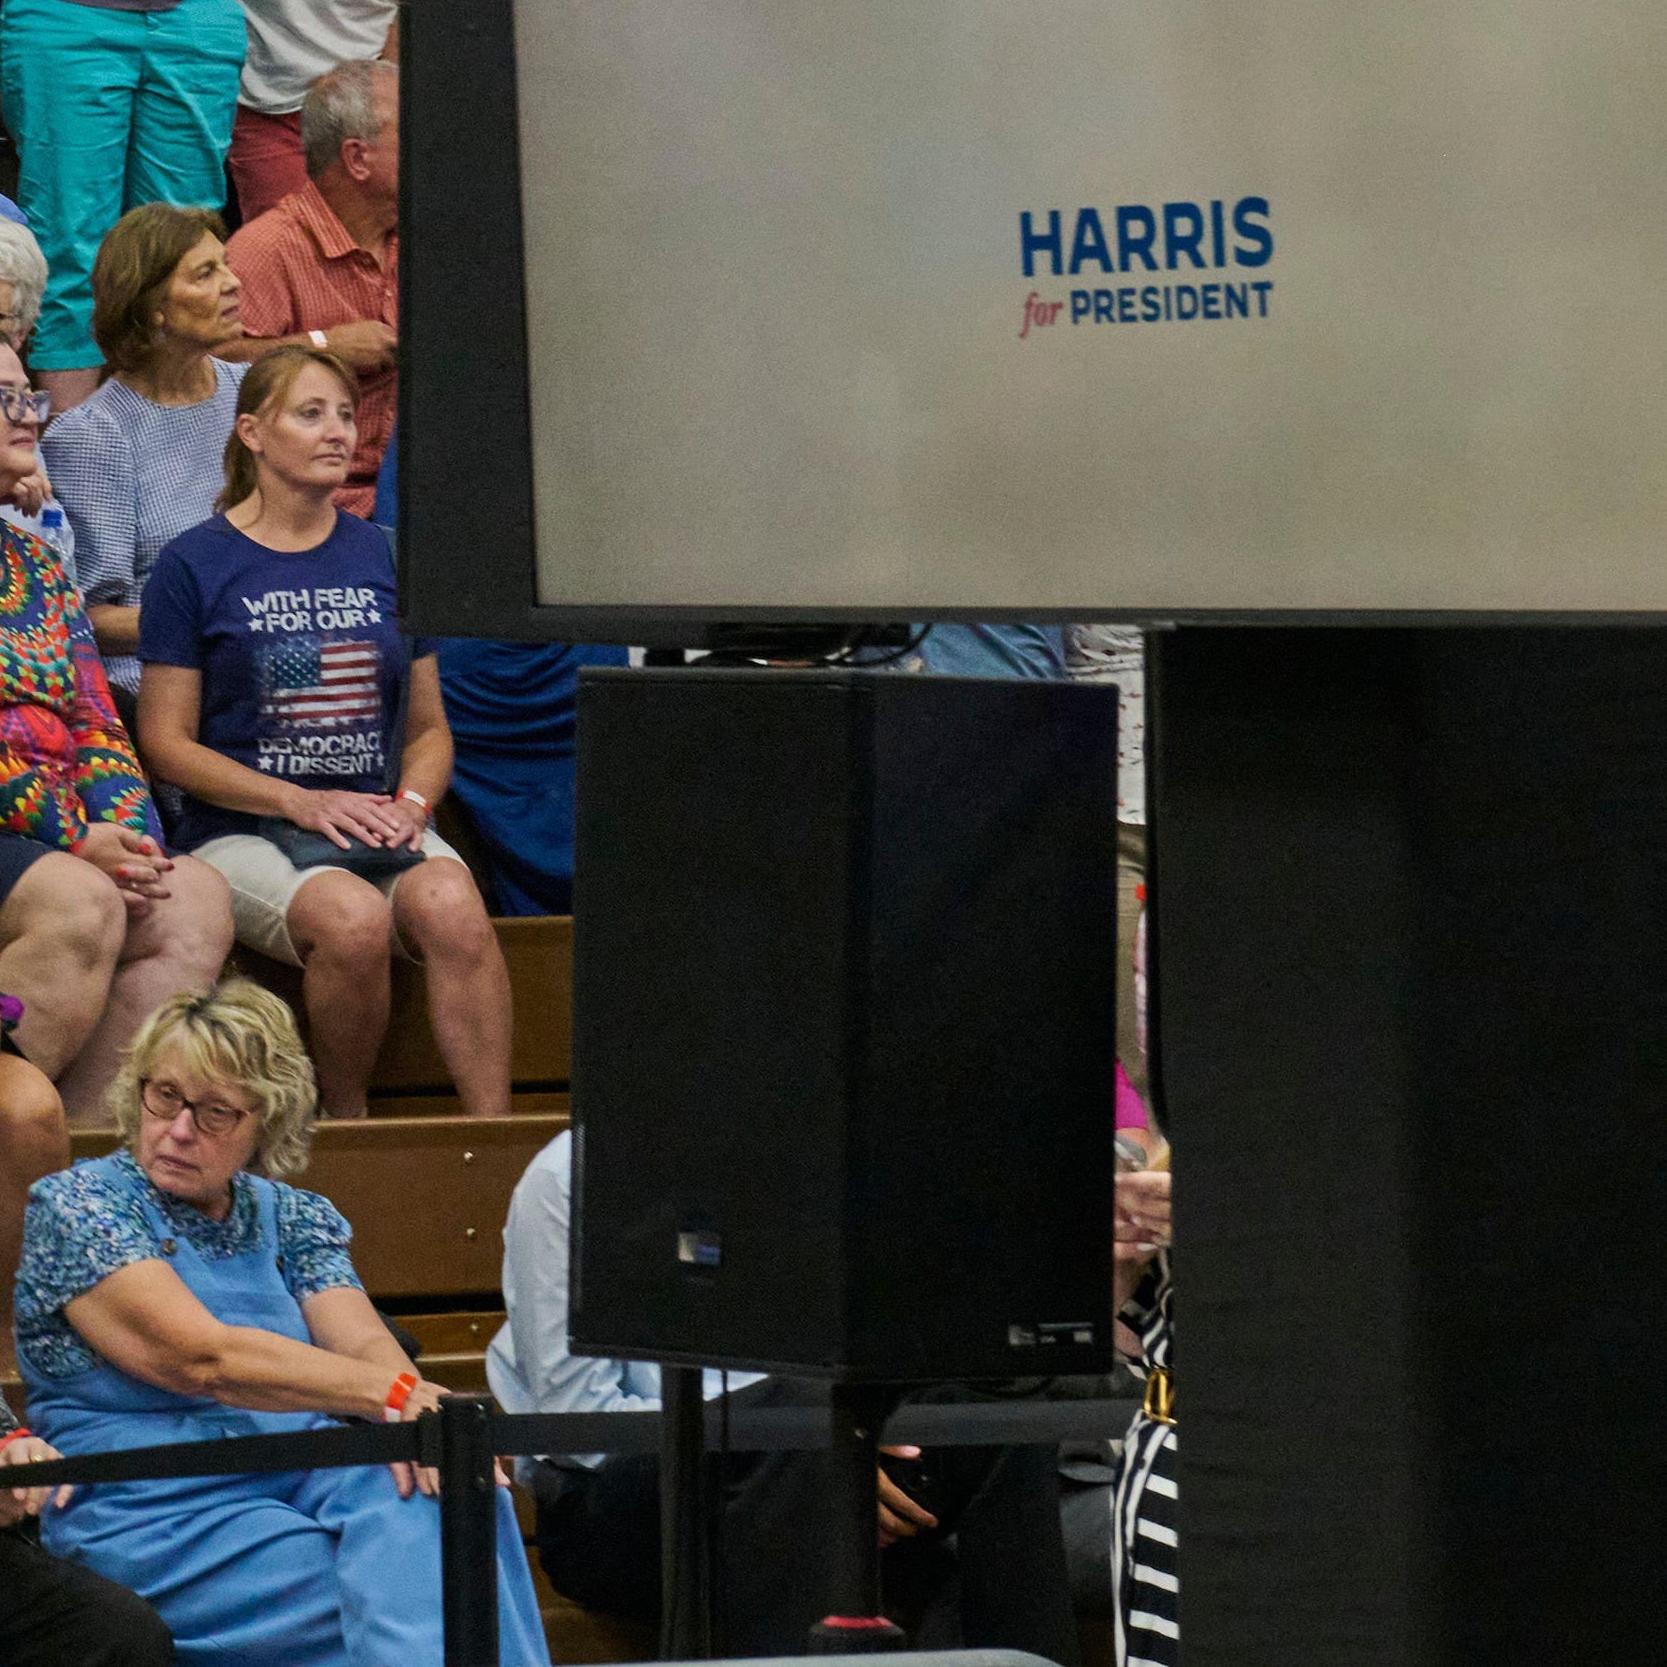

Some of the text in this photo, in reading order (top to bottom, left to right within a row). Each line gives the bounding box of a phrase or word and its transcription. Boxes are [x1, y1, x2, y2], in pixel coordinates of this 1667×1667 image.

[1019, 196, 1275, 278] HARRIS
[1018, 281, 1274, 338] for PRESIDENT
[241, 587, 378, 616] WITH FEAR
[266, 609, 368, 633] FOR OUR
[258, 731, 382, 756] DEMOCRAC
[289, 753, 375, 776] DISSENT
